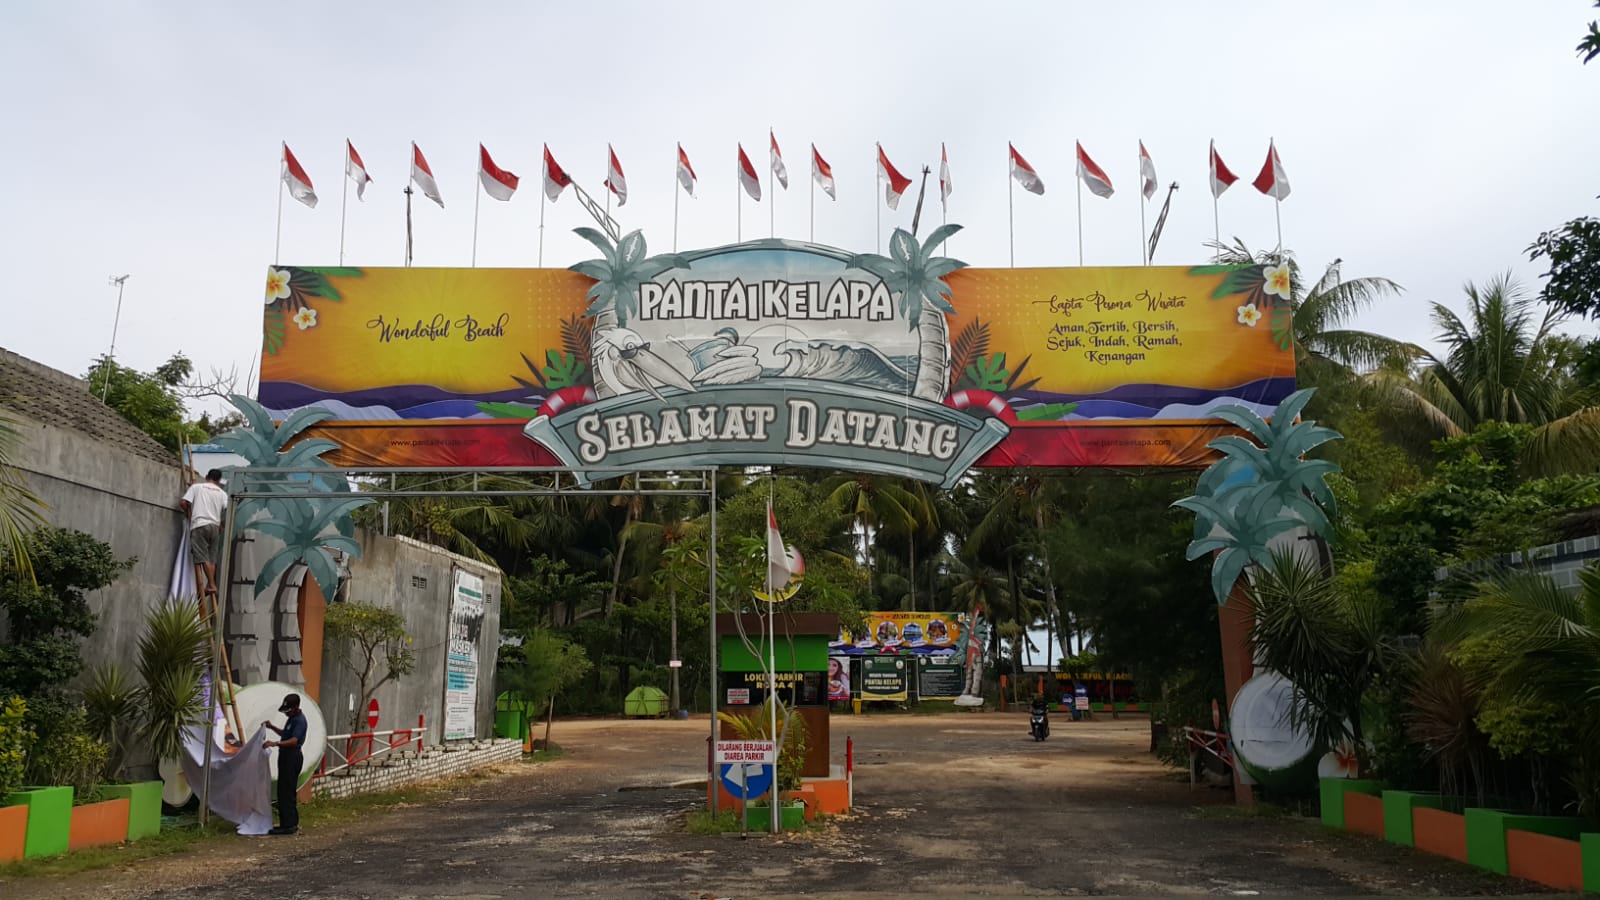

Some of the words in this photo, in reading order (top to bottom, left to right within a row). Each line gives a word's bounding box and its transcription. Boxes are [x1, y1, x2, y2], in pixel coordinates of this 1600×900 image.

[639, 277, 760, 321] PANTAI
[760, 277, 894, 321] KELAPA
[1032, 294, 1084, 317] Sapta
[1086, 291, 1133, 313] Pesona
[1135, 290, 1187, 312] Wisata
[366, 313, 450, 343] Wonderful
[454, 312, 510, 342] Beach
[1046, 335, 1086, 352] Sejuk,
[1088, 335, 1130, 348] Indah,
[1132, 334, 1183, 350] Ramah,
[1084, 350, 1146, 366] Kenangan
[575, 402, 777, 464] SELAMAT
[784, 398, 961, 461] DATANG
[717, 743, 742, 752] DILARANG
[743, 743, 773, 752] BERJUALAN
[724, 752, 744, 761] DIAREA
[745, 752, 765, 761] PARKIR
